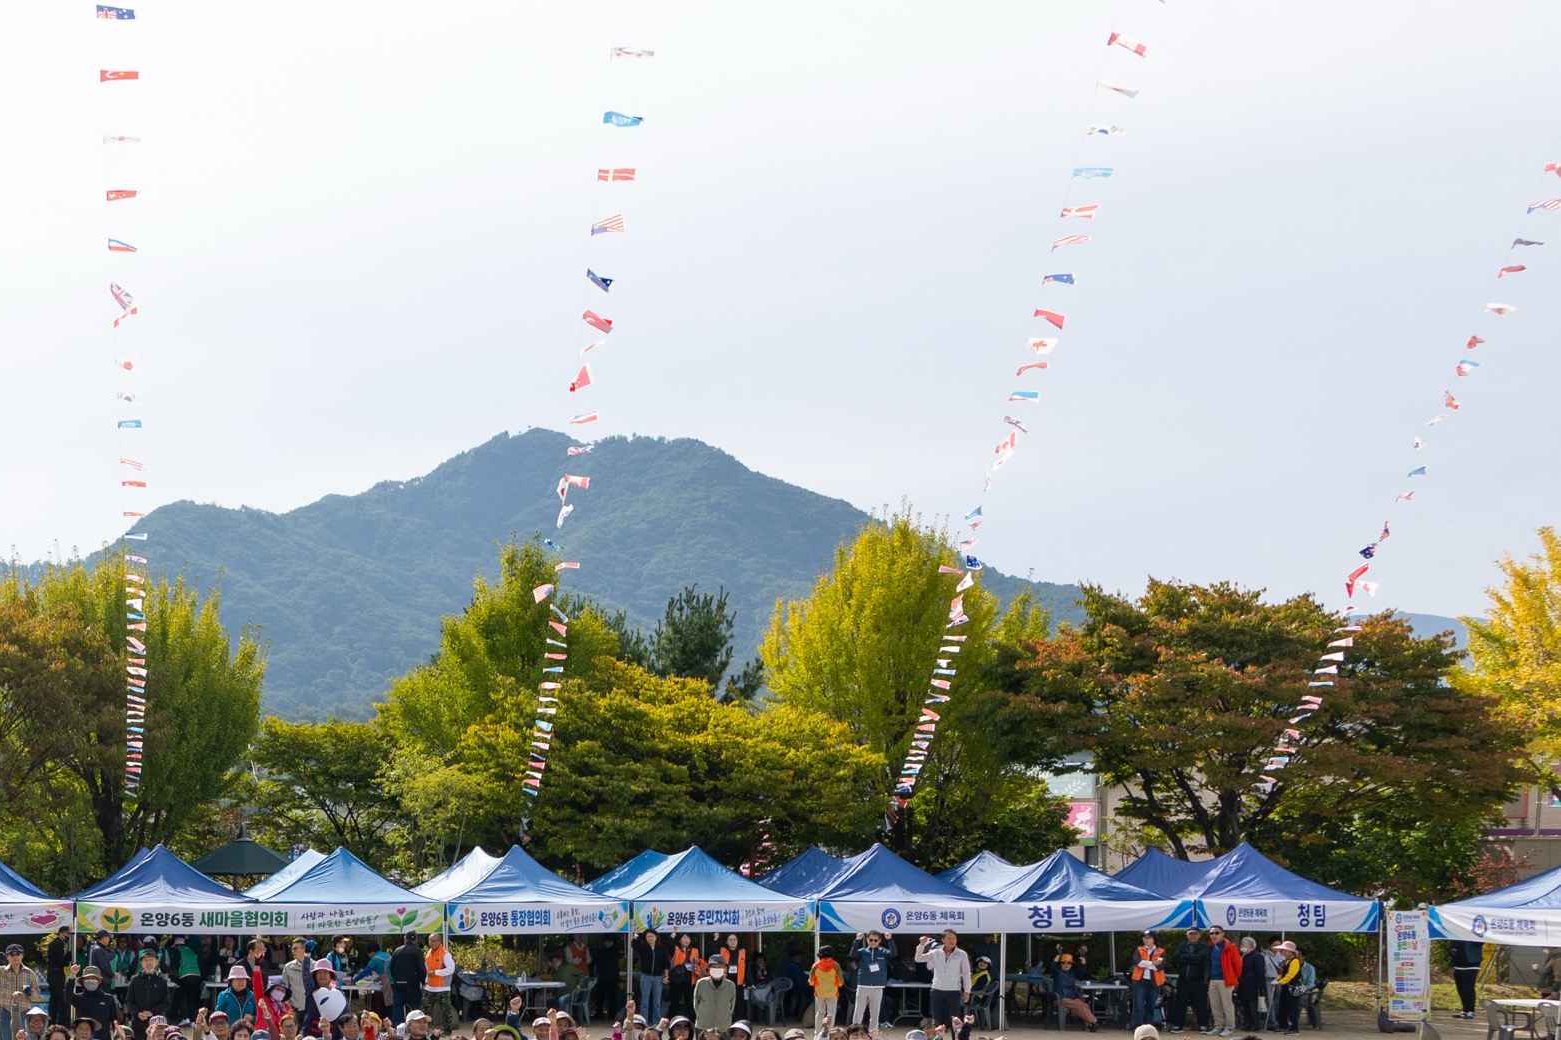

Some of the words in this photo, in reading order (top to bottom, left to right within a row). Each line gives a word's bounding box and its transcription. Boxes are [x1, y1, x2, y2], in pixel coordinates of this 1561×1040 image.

[140, 912, 195, 928] 온양6동
[199, 911, 289, 928] 새마을협의회
[480, 911, 509, 927] 온양6동
[510, 909, 551, 927] 통장협의회
[667, 911, 696, 926] 온양6동
[697, 909, 740, 926] 주민자치회
[905, 911, 938, 921] 온양6동
[940, 911, 965, 921] 체육회
